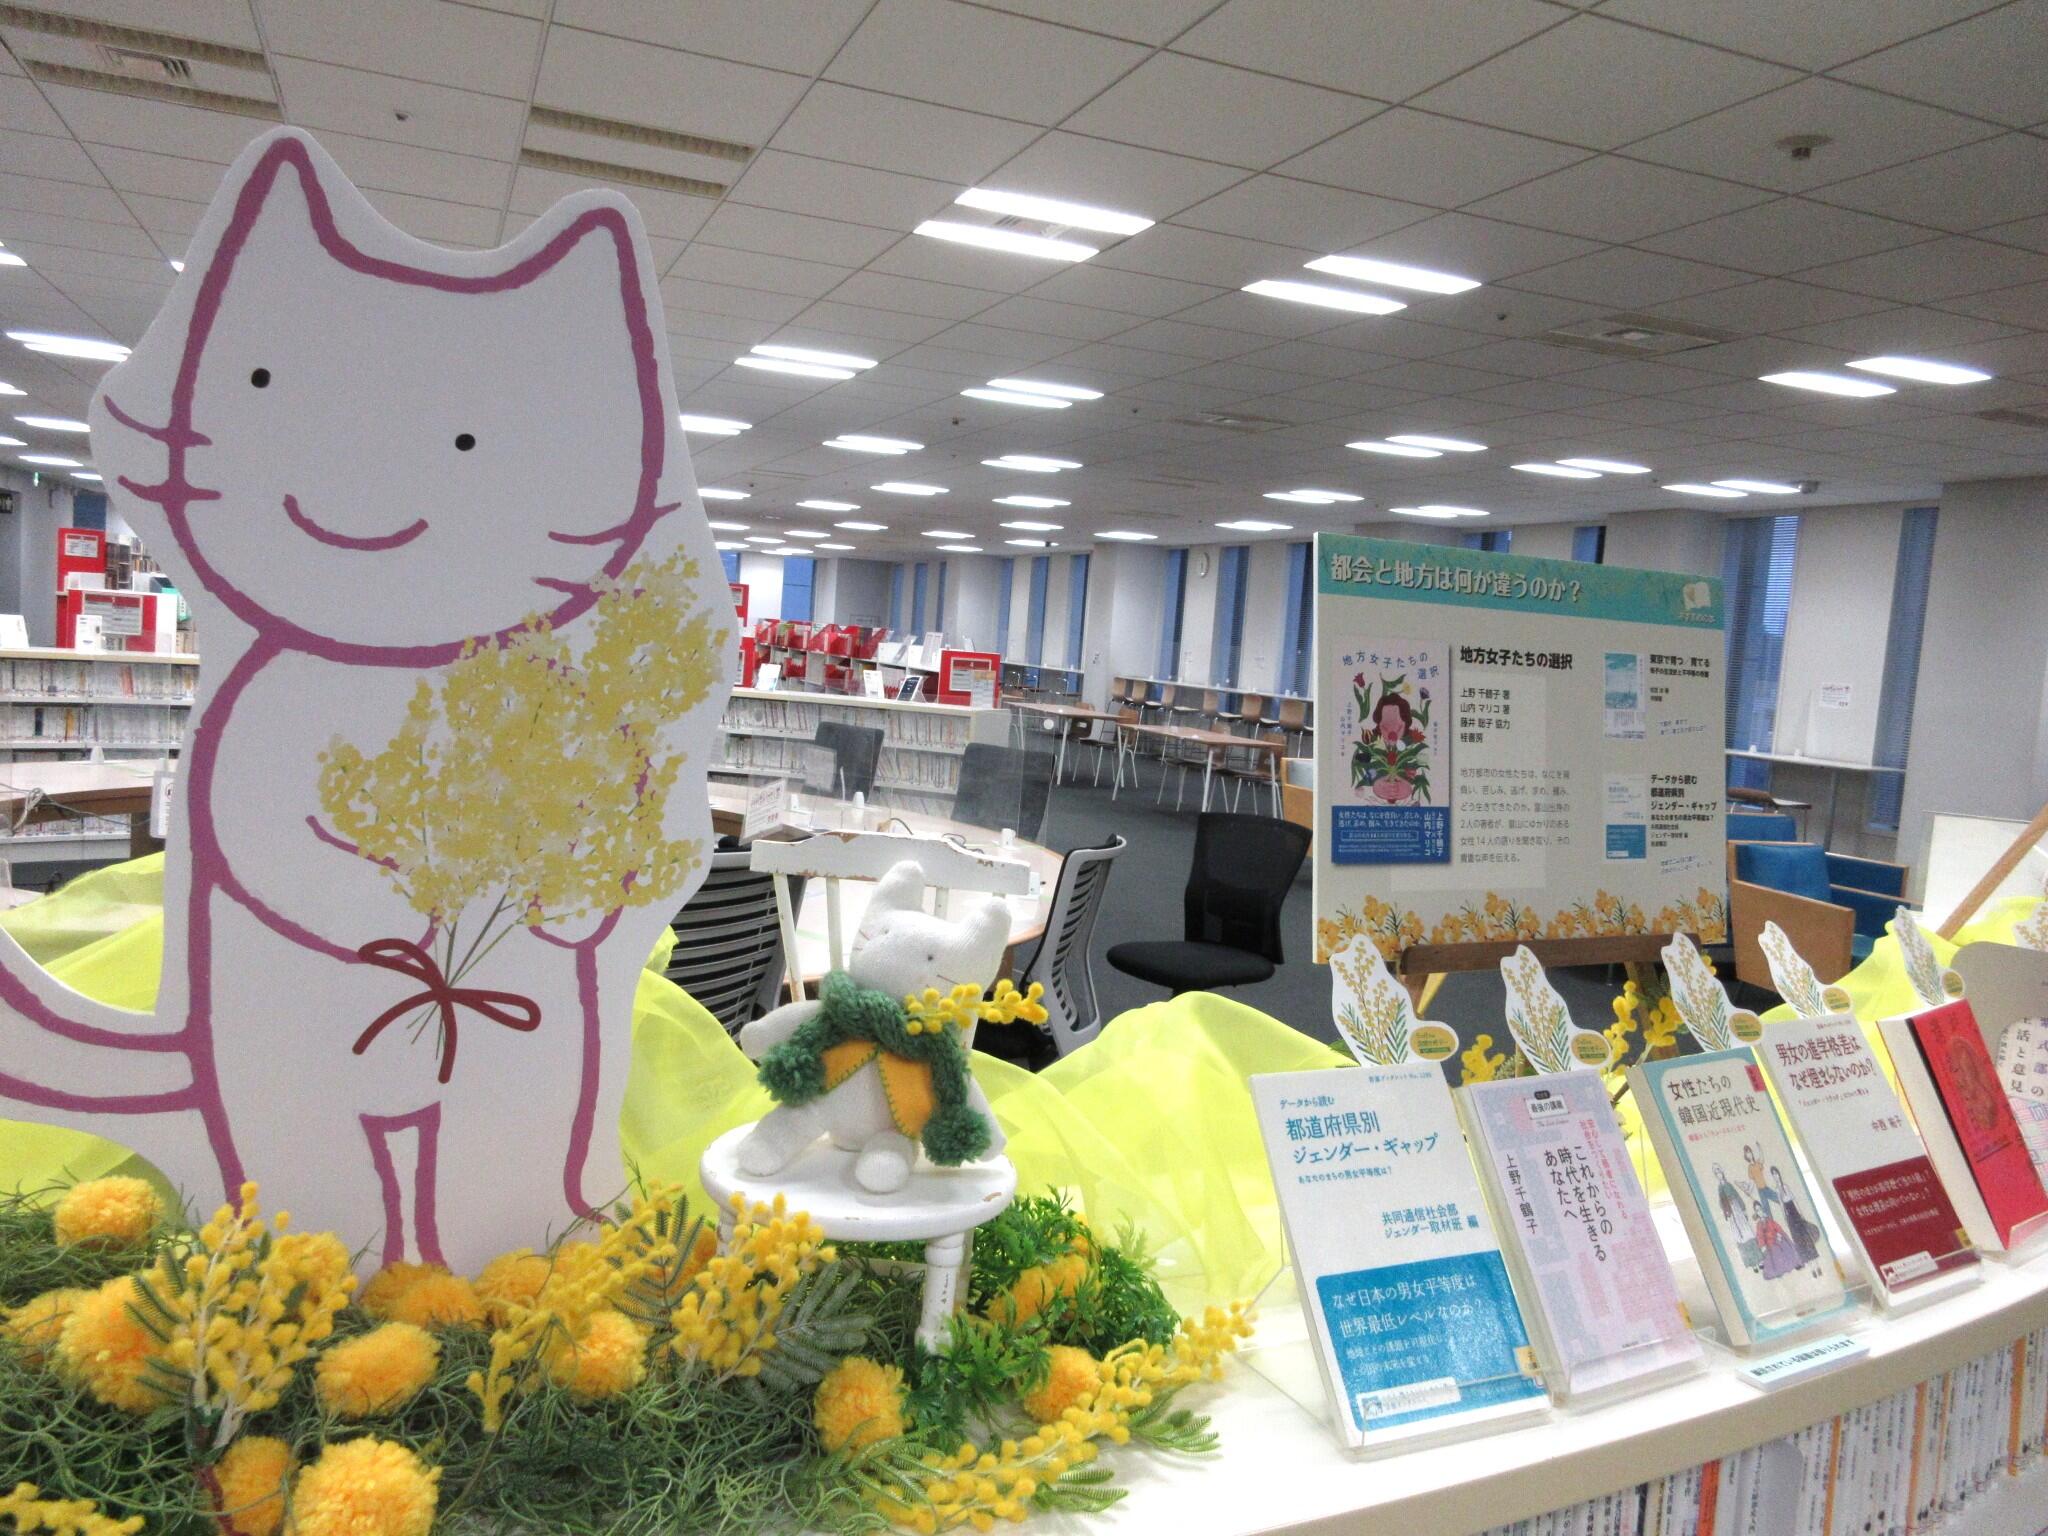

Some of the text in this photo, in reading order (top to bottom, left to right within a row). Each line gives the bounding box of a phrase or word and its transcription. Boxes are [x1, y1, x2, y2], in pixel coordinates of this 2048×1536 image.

[1330, 552, 1581, 603] 都会と地方は何が違うのか？
[1460, 645, 1574, 671] 地方女子たちの選択
[1460, 687, 1476, 699] 上野
[1460, 703, 1476, 714] 山内
[1478, 704, 1500, 714] マリコ
[1775, 1033, 1863, 1067] 男女の進学格差は
[1667, 1075, 1732, 1102] 女性たちの
[1789, 1057, 1878, 1091] なぜ埋まらないのか？
[1279, 1095, 1336, 1110] データから読む
[1677, 1094, 1761, 1127] 韓国近現代史
[1285, 1110, 1381, 1141] 都道府県別
[1293, 1131, 1439, 1164] ジェンダー・ギャップ
[1506, 1153, 1538, 1235] 上野千鶴子
[1543, 1149, 1578, 1220] あなたへ
[1573, 1145, 1613, 1235] これからの
[1557, 1148, 1606, 1262] 時代を生きる
[1331, 1274, 1477, 1309] なぜ日本の男女平等度は
